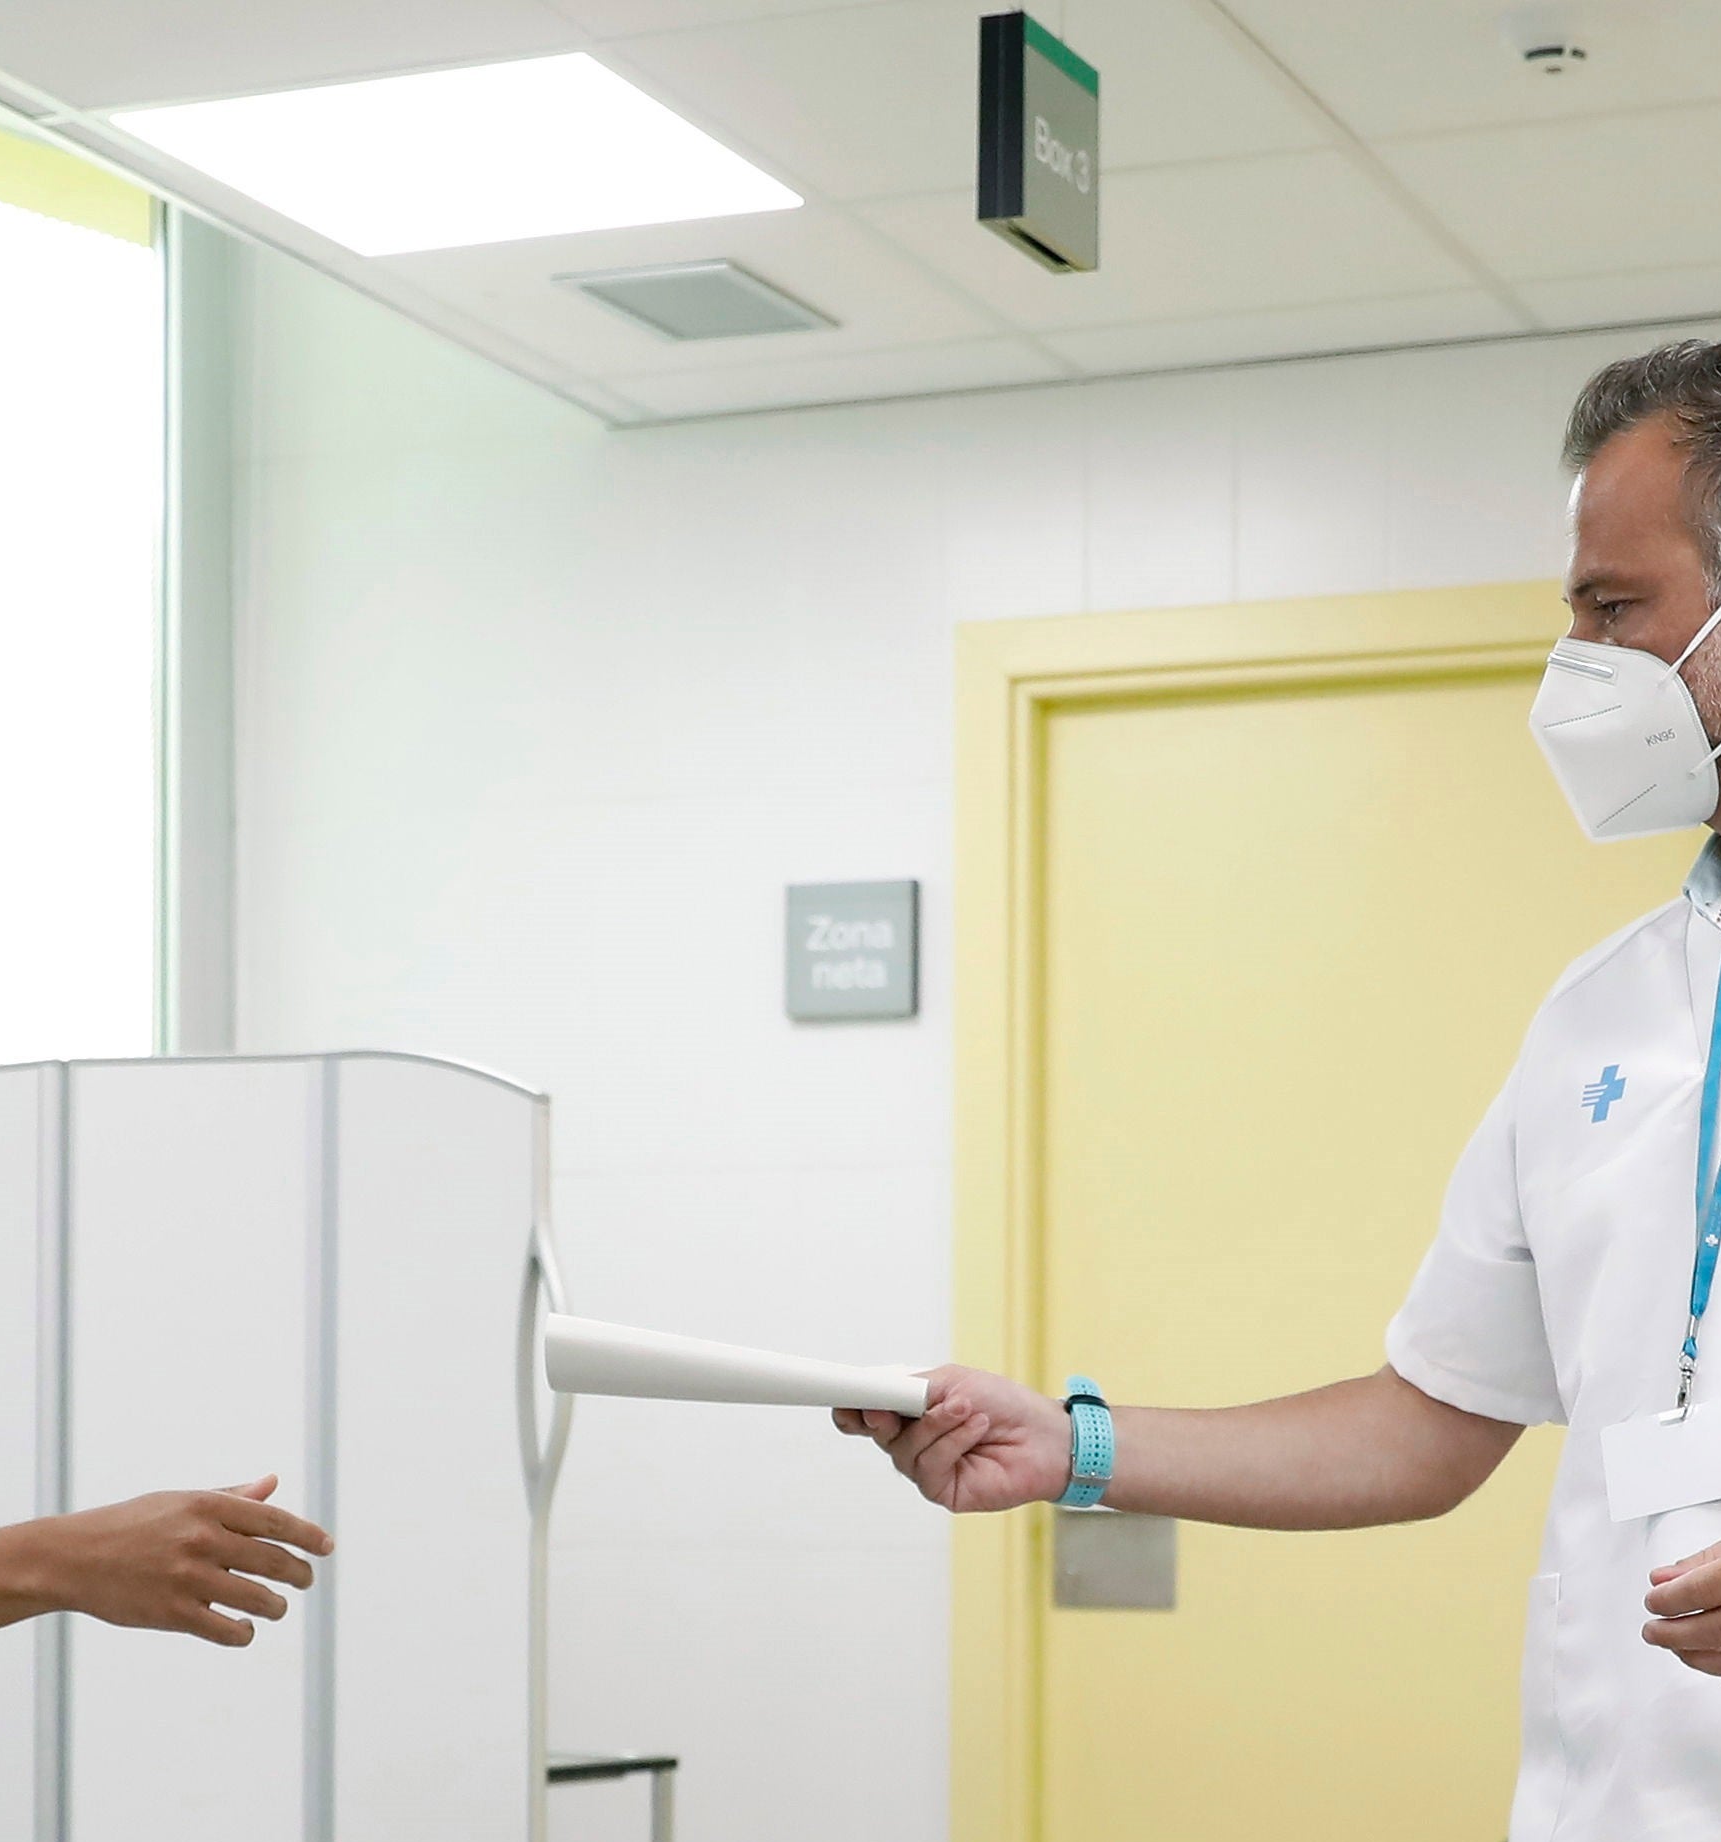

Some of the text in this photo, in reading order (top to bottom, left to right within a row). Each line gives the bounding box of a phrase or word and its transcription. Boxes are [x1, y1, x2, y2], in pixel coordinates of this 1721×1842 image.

[1034, 114, 1073, 183] Box
[1645, 728, 1677, 747] KN95
[806, 915, 894, 951] Zona
